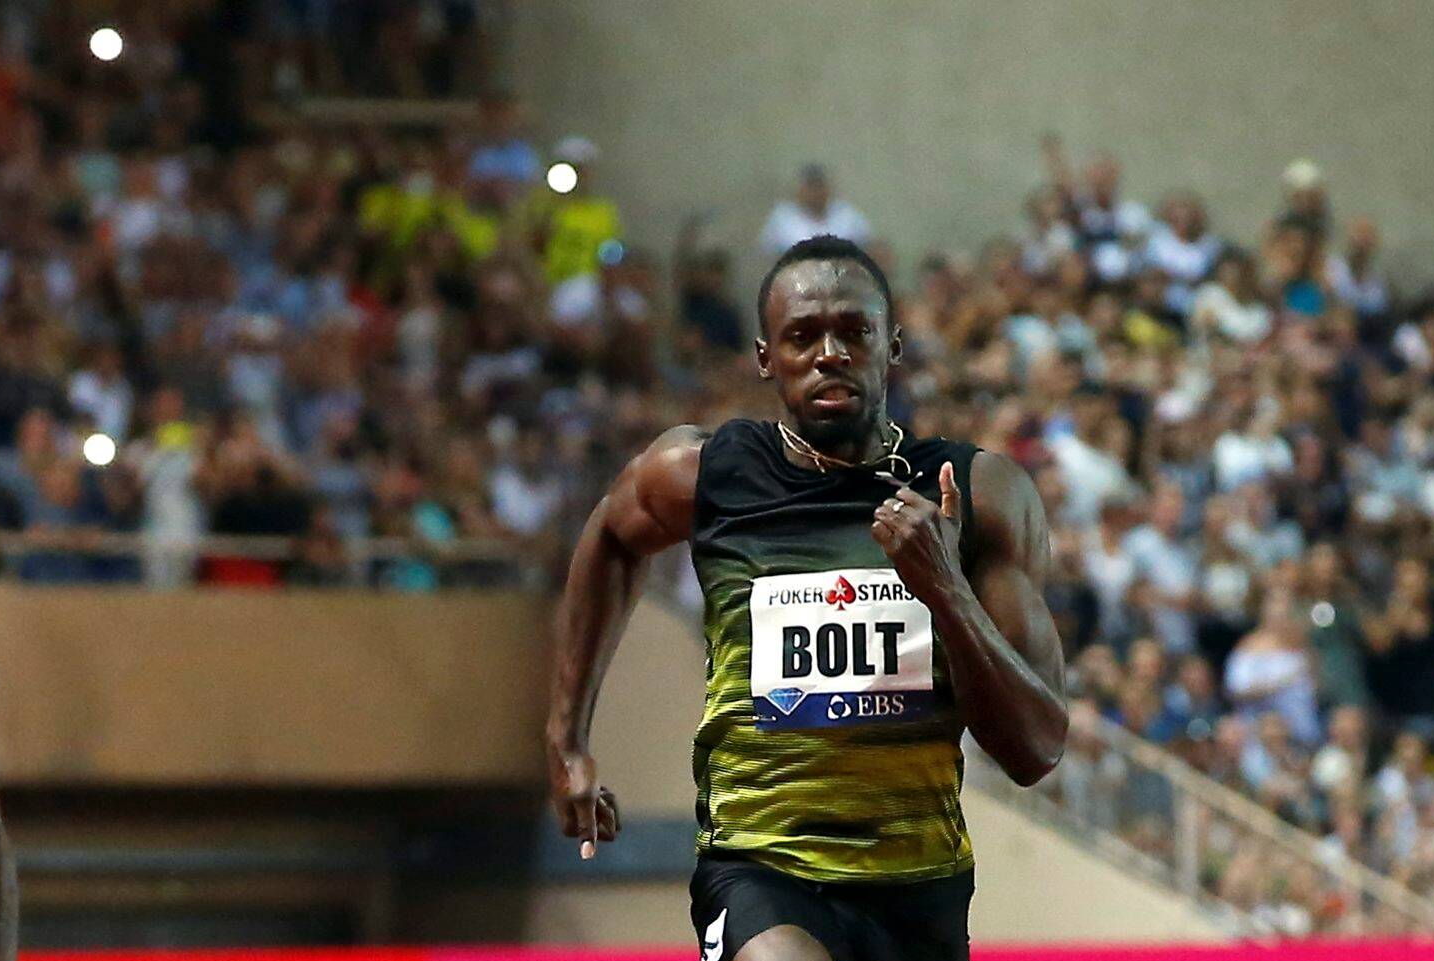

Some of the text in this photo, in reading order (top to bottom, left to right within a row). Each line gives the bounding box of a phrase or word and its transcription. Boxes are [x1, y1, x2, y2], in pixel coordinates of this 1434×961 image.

[768, 584, 916, 606] POKER STARS
[782, 622, 905, 679] BOLT
[856, 695, 904, 717] EBS
